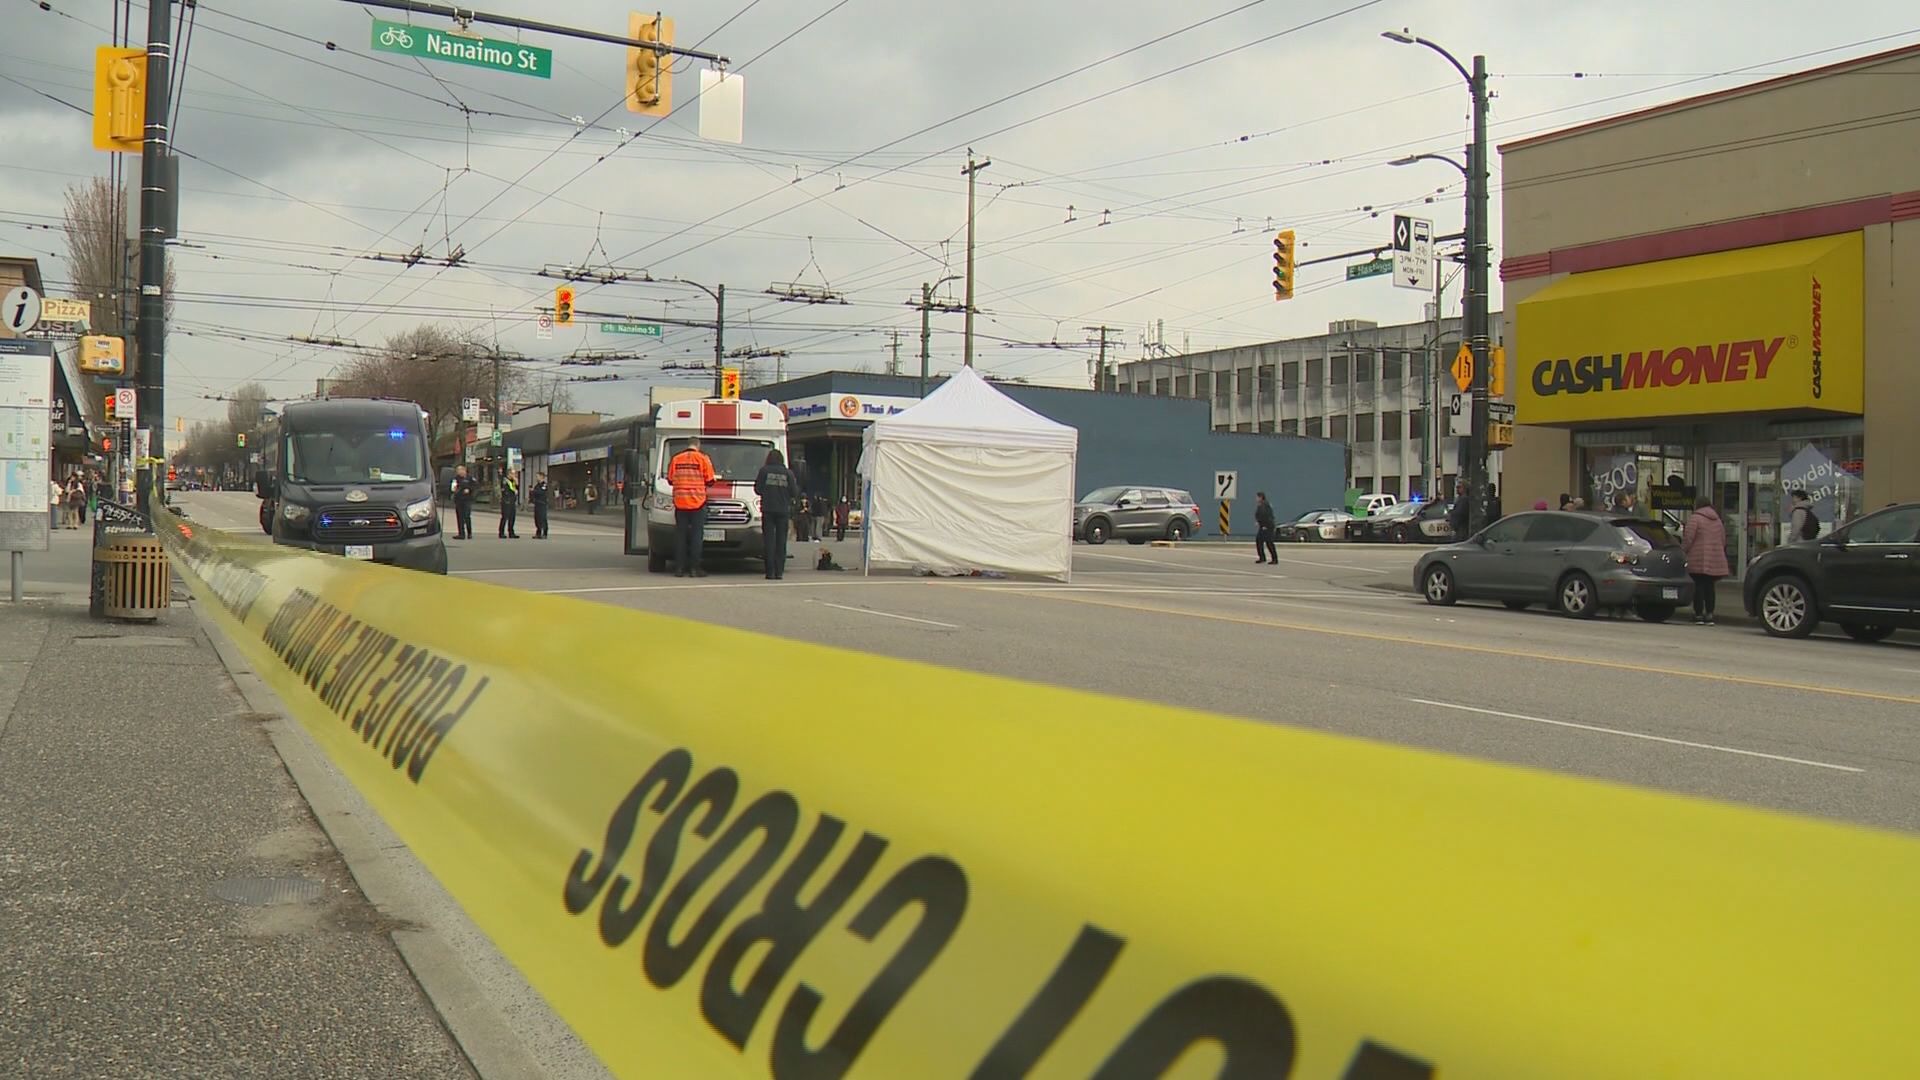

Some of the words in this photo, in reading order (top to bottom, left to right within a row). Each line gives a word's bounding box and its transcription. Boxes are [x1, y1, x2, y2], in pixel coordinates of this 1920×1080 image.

[427, 33, 513, 66] Nanaimo
[517, 50, 537, 71] St
[1358, 262, 1392, 275] Hastings
[618, 325, 648, 334] Nanaimo
[648, 326, 656, 335] St
[1812, 275, 1821, 399] CASHMONEY
[1532, 337, 1785, 396] CASHMONEY
[862, 404, 884, 415] Thai
[494, 431, 500, 440] P
[1593, 462, 1637, 496] $300
[1781, 460, 1833, 495] Payday
[351, 643, 489, 785] POLICE
[564, 748, 969, 1080] CROSS
